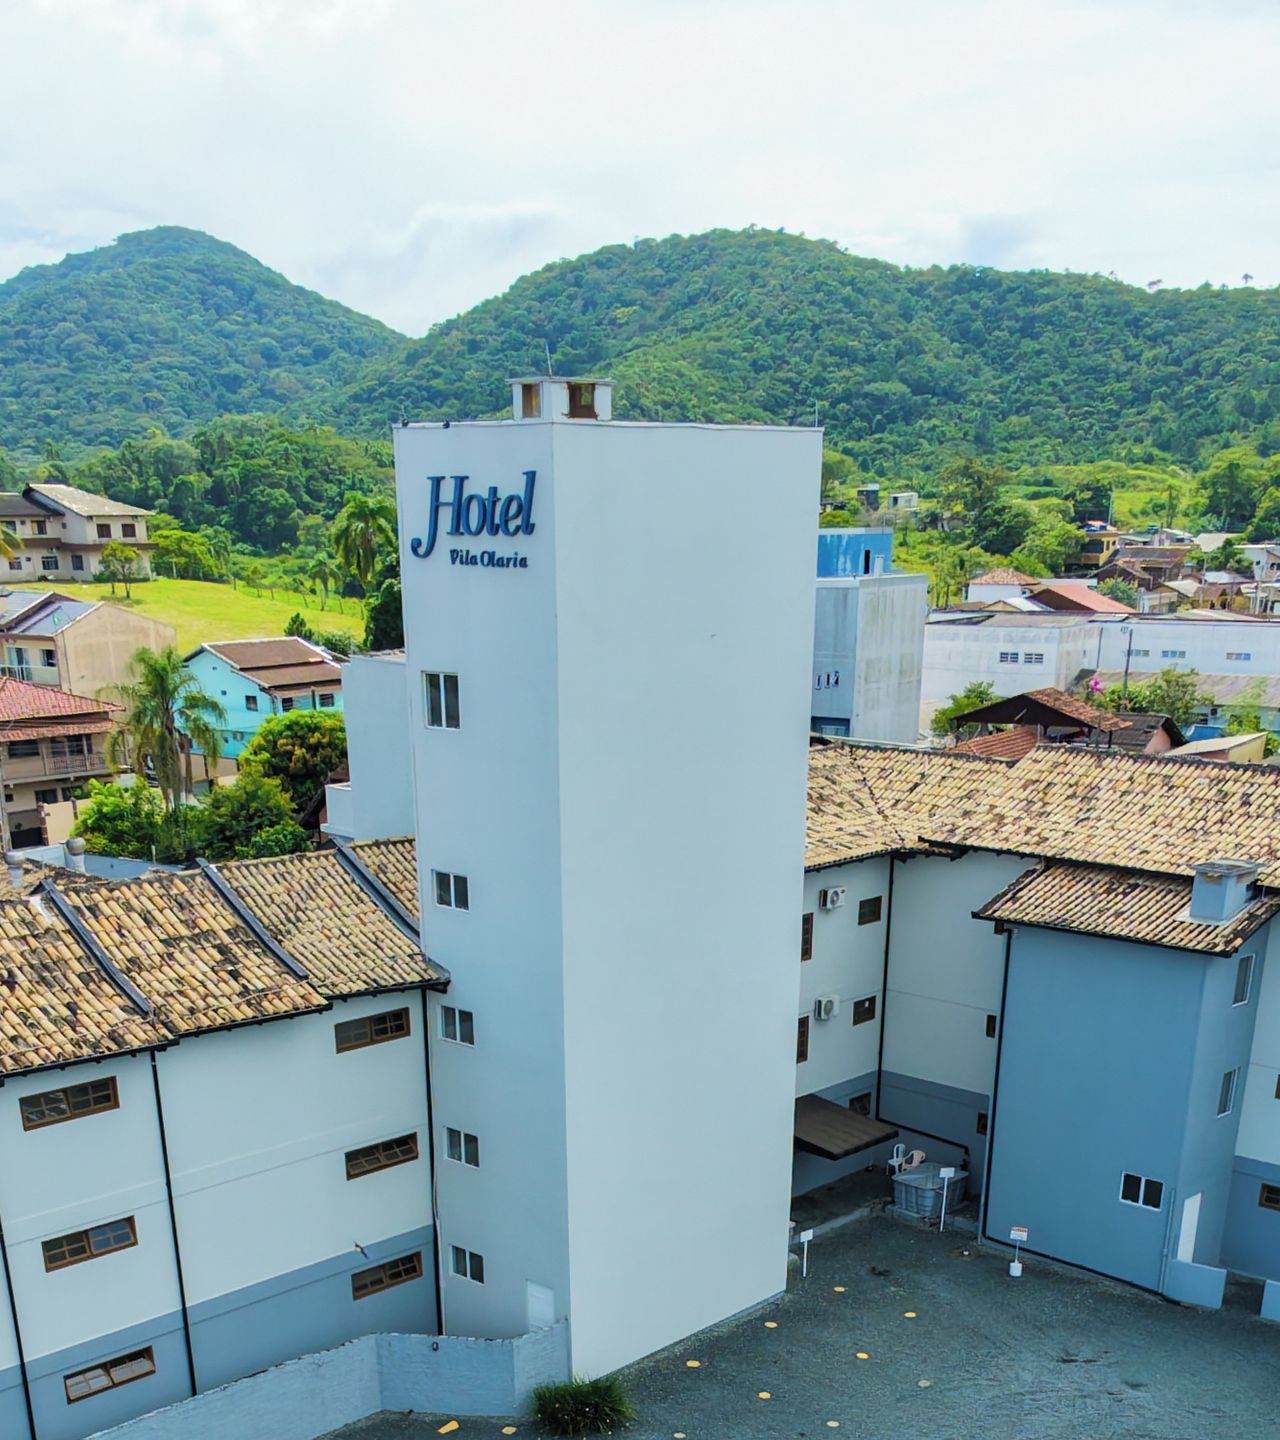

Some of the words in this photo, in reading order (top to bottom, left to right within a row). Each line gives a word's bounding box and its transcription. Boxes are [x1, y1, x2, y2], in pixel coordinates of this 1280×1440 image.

[411, 470, 536, 559] Hotel
[450, 549, 478, 566] Vila
[480, 551, 528, 568] Olaria
